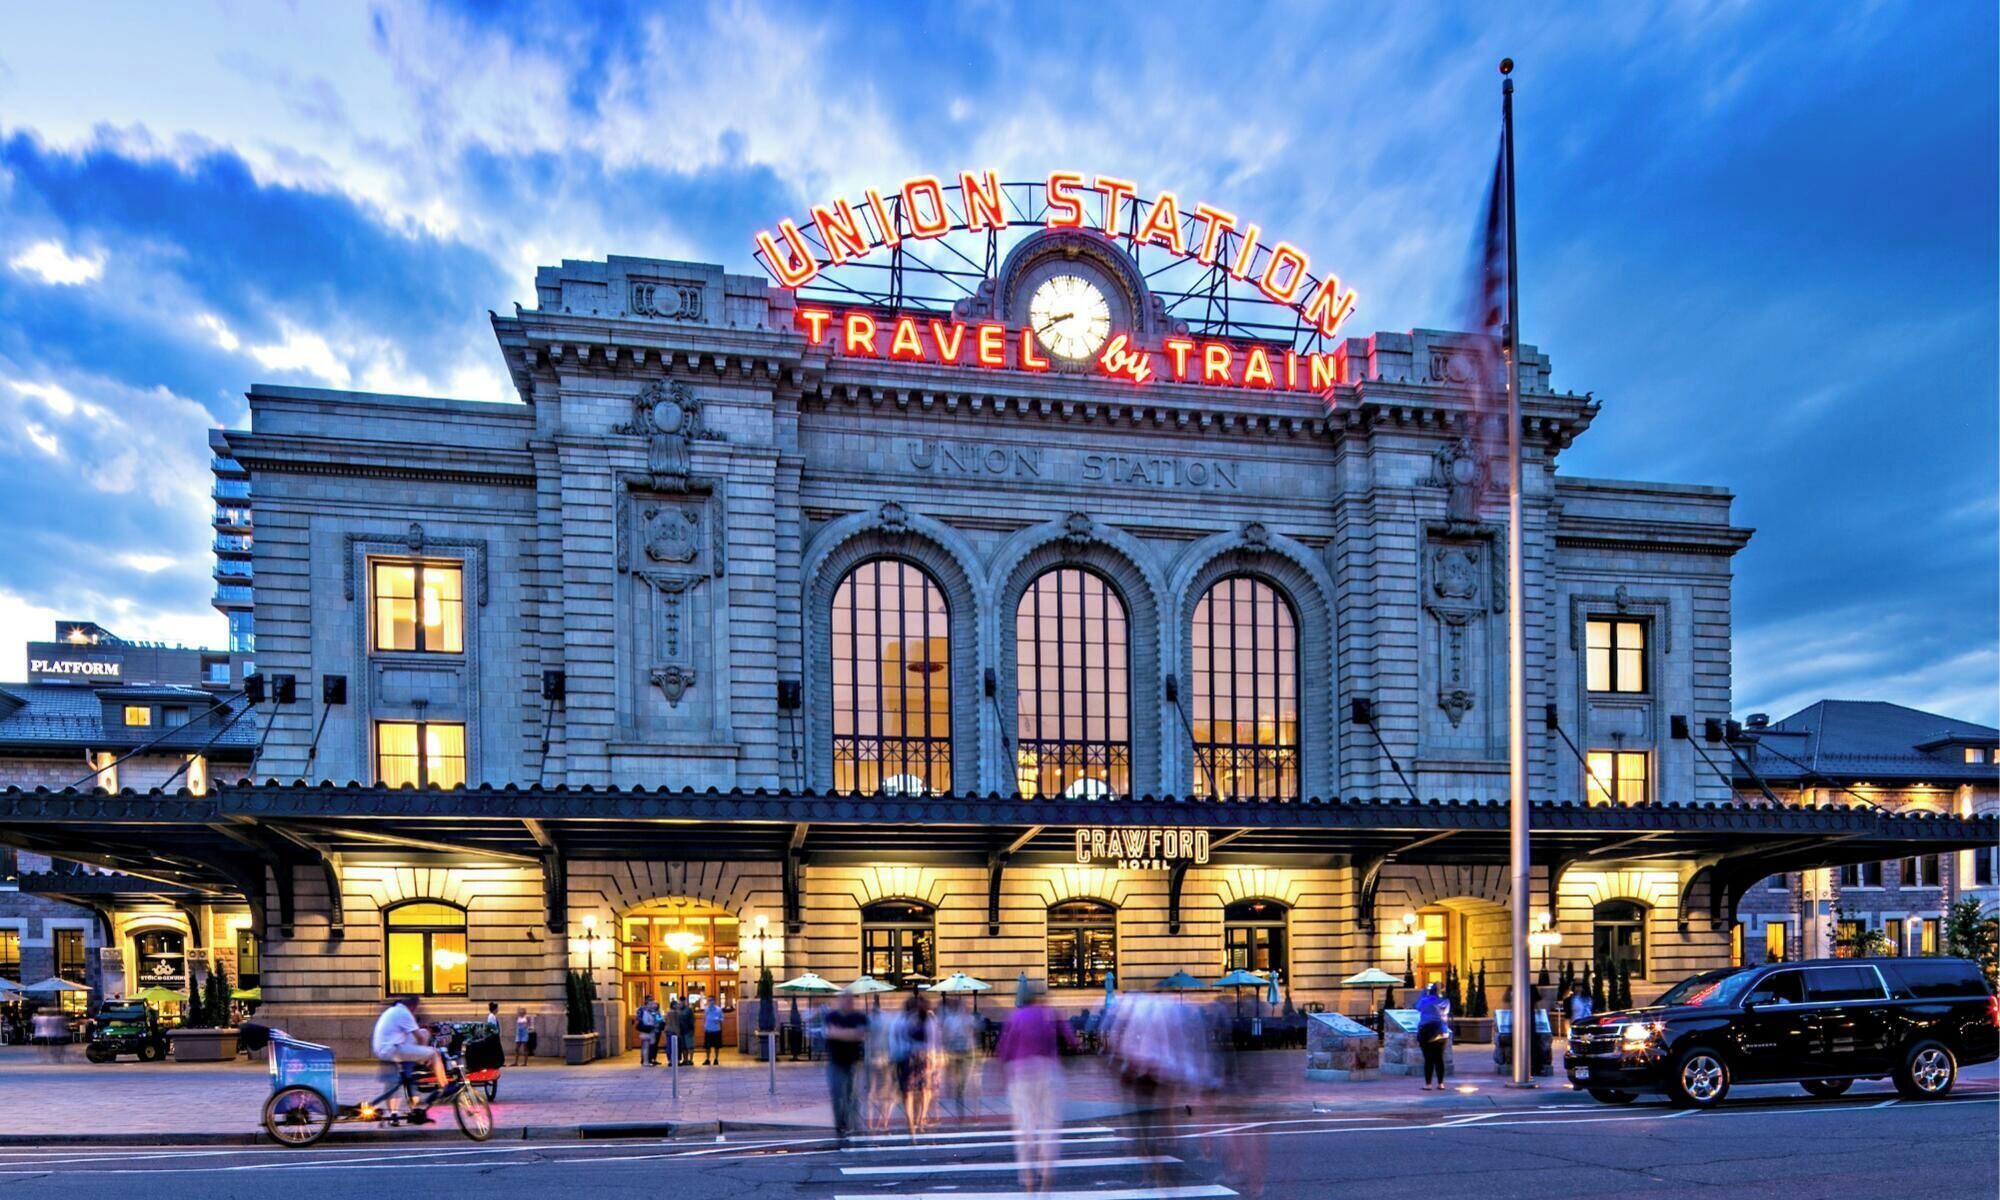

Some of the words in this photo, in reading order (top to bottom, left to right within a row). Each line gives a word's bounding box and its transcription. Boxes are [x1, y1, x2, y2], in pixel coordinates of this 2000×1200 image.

[756, 168, 1008, 288] UNION
[1046, 170, 1358, 339] STATION
[797, 308, 1050, 371] TRAVEL
[1099, 334, 1152, 382] by
[1164, 338, 1337, 392] TRAIN
[907, 442, 1042, 477] UNION
[1082, 454, 1240, 489] STATION
[30, 659, 120, 676] PLATFORM
[1076, 829, 1209, 864] CRAWFORD
[1117, 859, 1171, 870] HOTEL
